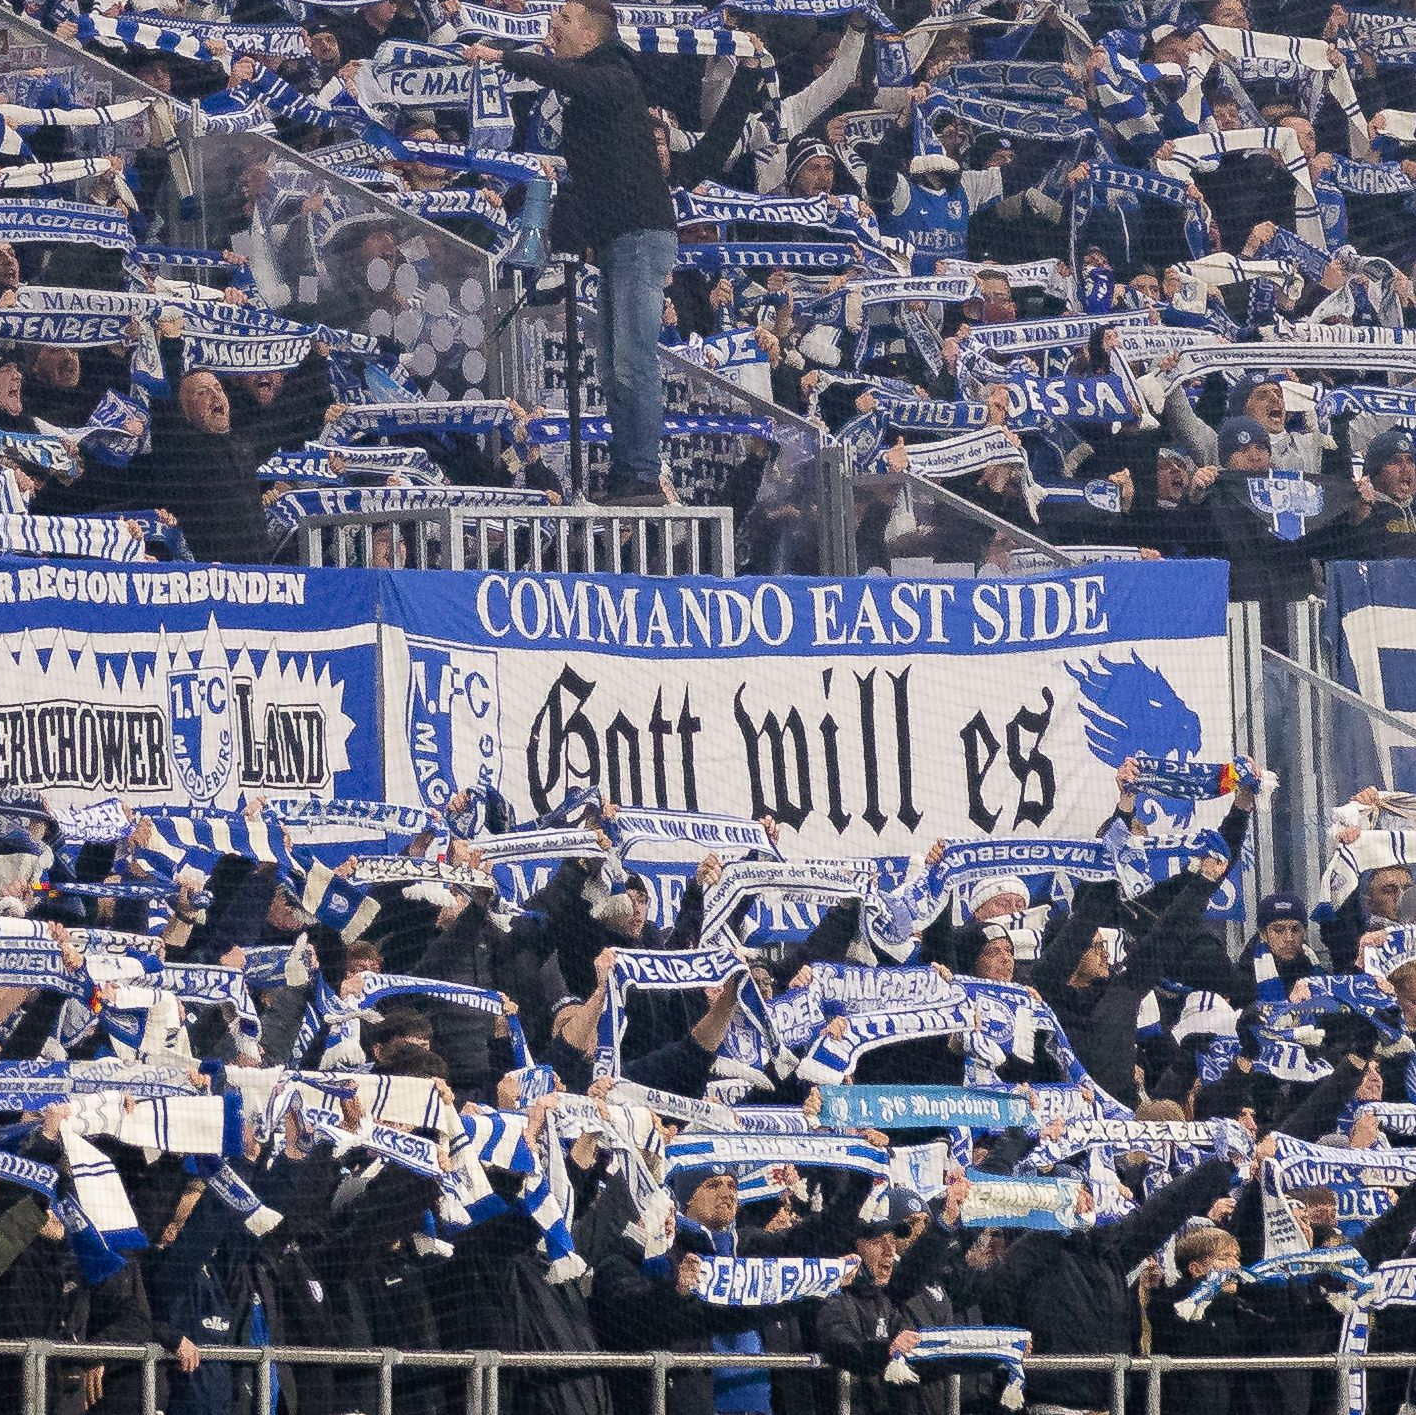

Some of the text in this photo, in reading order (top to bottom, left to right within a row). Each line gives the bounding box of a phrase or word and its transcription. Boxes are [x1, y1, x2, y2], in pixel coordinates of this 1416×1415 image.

[469, 10, 540, 36] VON DER
[391, 68, 418, 95] FC
[720, 246, 854, 267] immer
[1018, 324, 1057, 347] VON
[325, 491, 359, 513] FC
[21, 567, 127, 604] REGION
[137, 570, 305, 605] VERBUNDEN
[475, 577, 1109, 649] COMMANDO EAST SIDE
[174, 679, 228, 721] 1.FC
[233, 677, 330, 790] LAND
[528, 663, 1058, 837] Gott will es
[692, 827, 764, 850] DER ELBE
[911, 1094, 1001, 1127] Magdeburg
